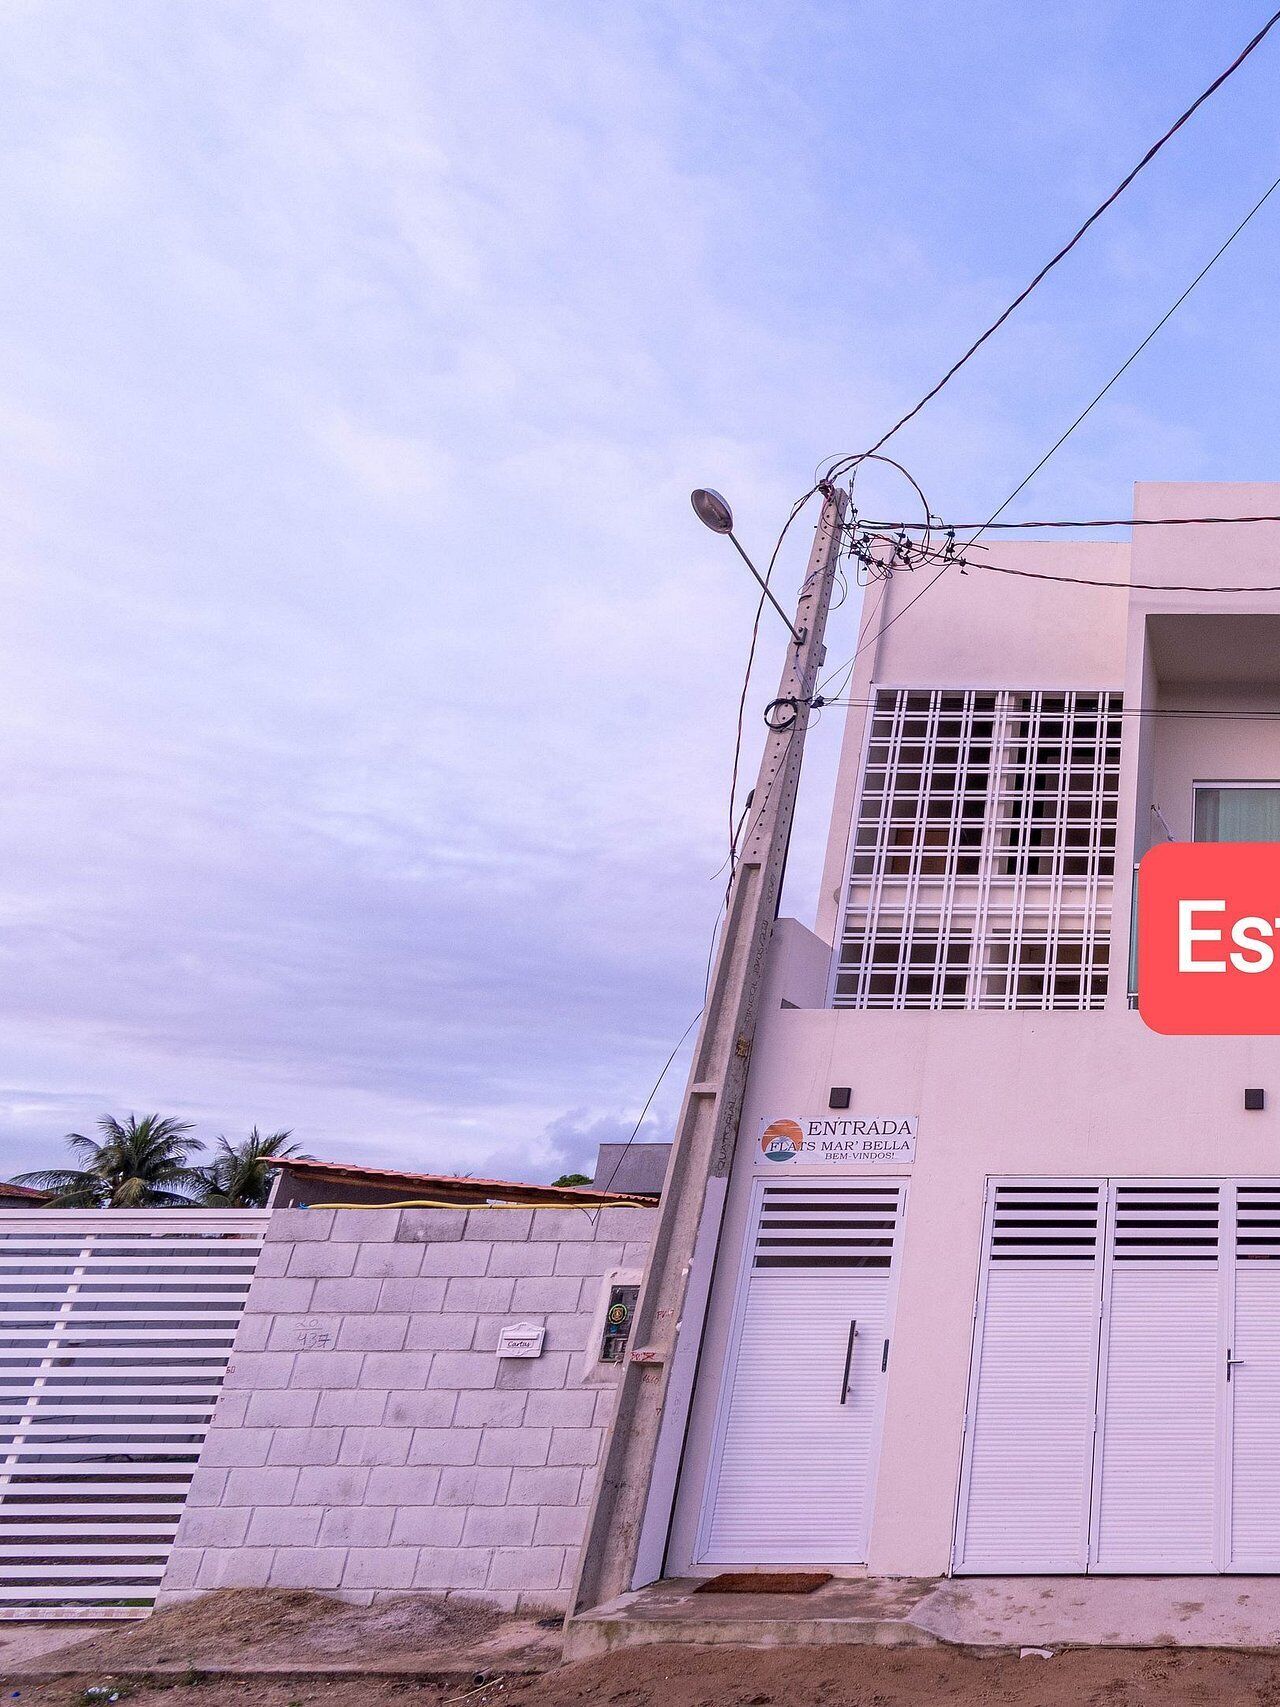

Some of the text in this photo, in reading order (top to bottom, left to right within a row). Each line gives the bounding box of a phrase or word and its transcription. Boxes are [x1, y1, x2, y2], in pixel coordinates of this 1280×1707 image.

[807, 1120, 913, 1136] ENTRADA
[769, 1140, 911, 1152] FLATS MAR' BELLA
[824, 1152, 895, 1160] BEM-VINDOS!
